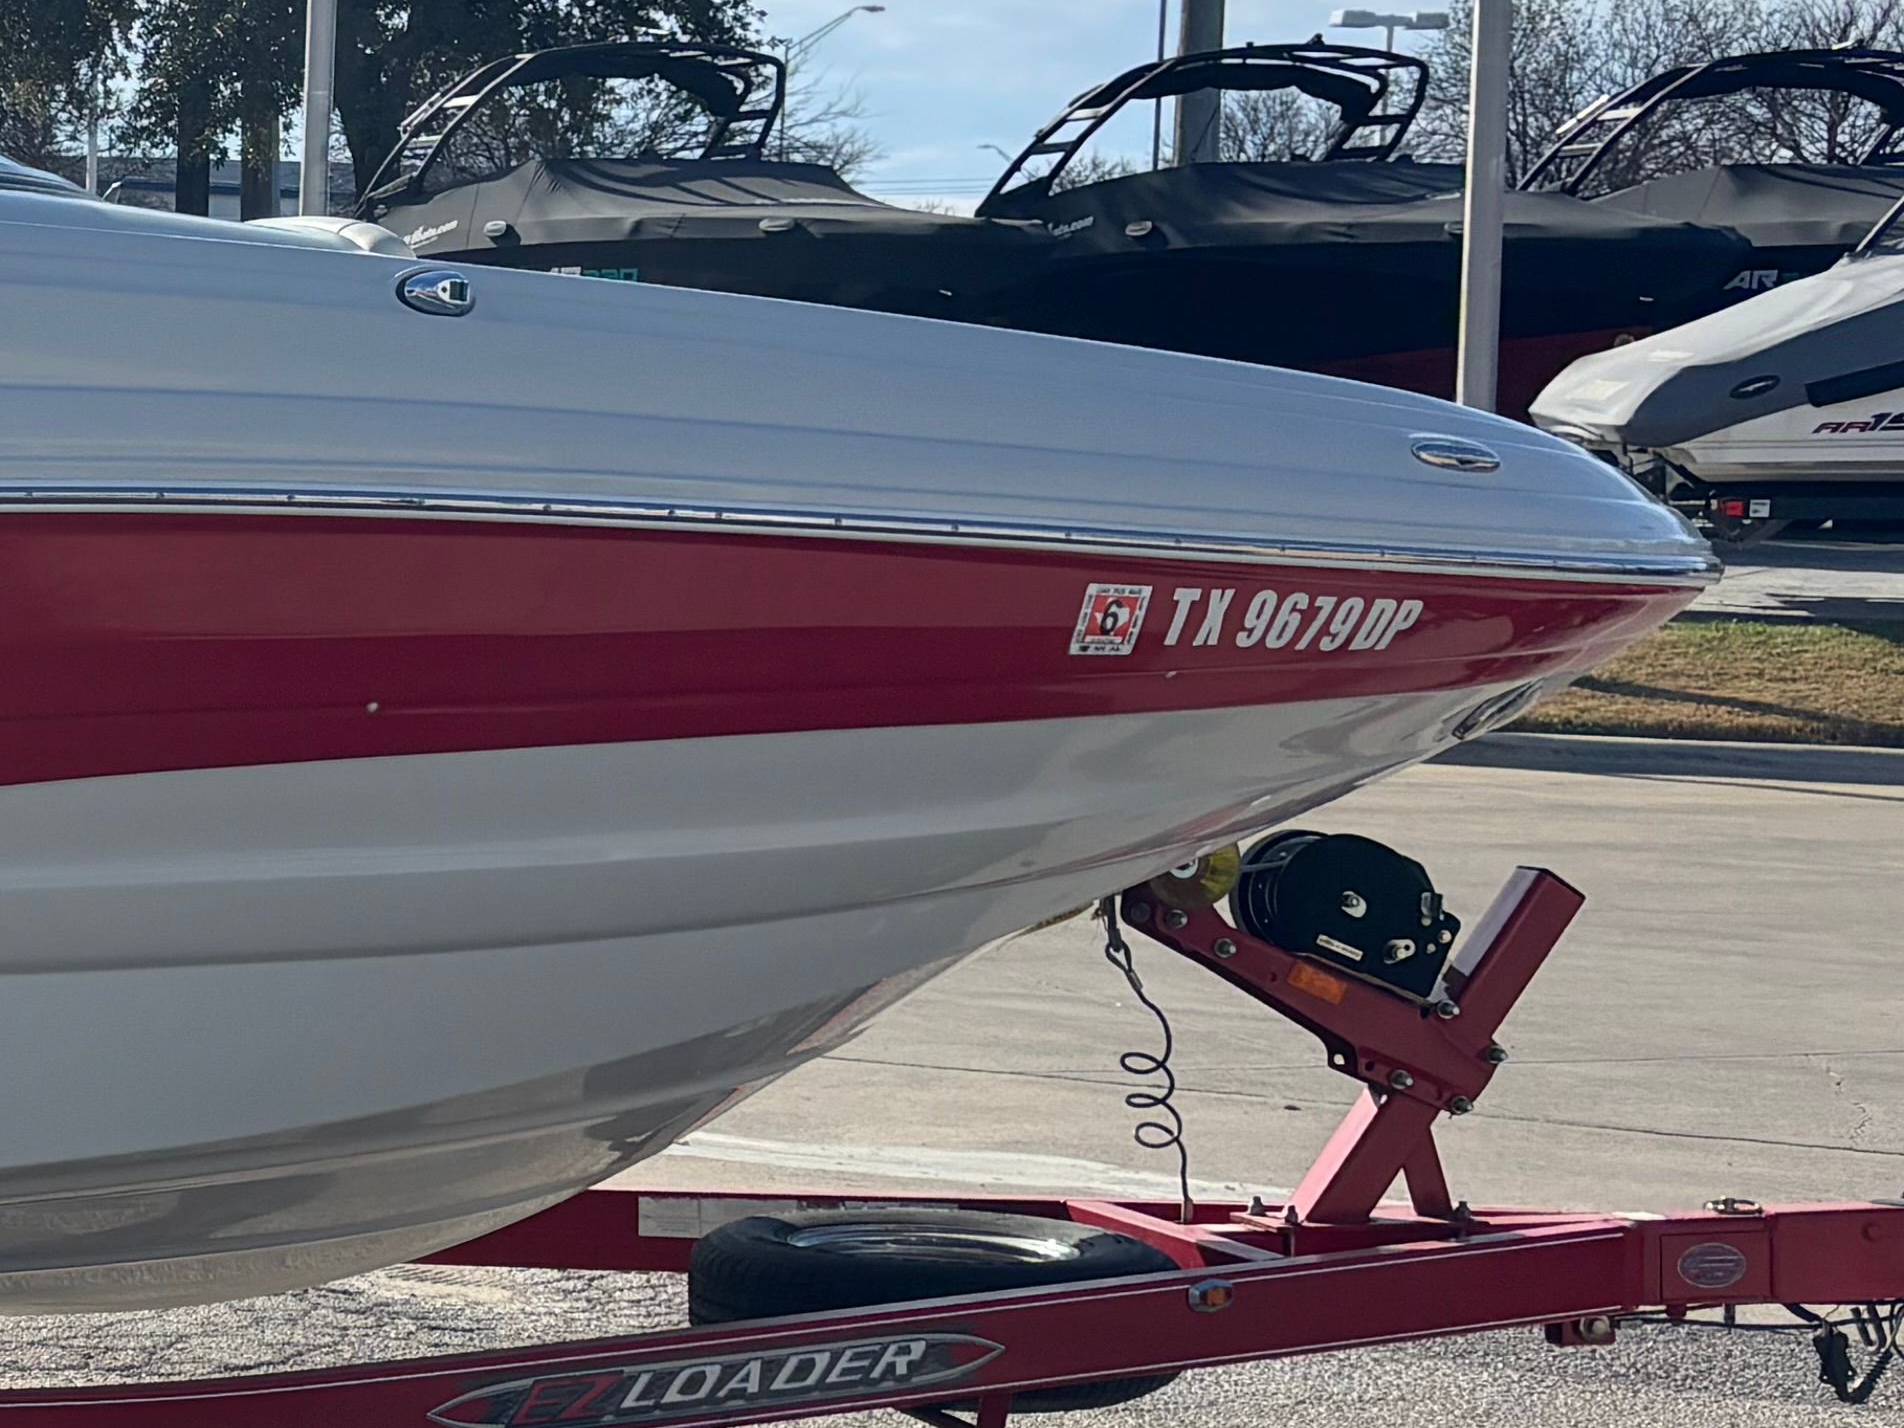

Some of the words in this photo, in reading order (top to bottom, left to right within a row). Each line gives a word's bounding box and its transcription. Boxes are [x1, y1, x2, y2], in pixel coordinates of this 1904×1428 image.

[1723, 269, 1778, 290] AR
[1163, 587, 1235, 647] TX
[1235, 589, 1424, 651] 9679DP
